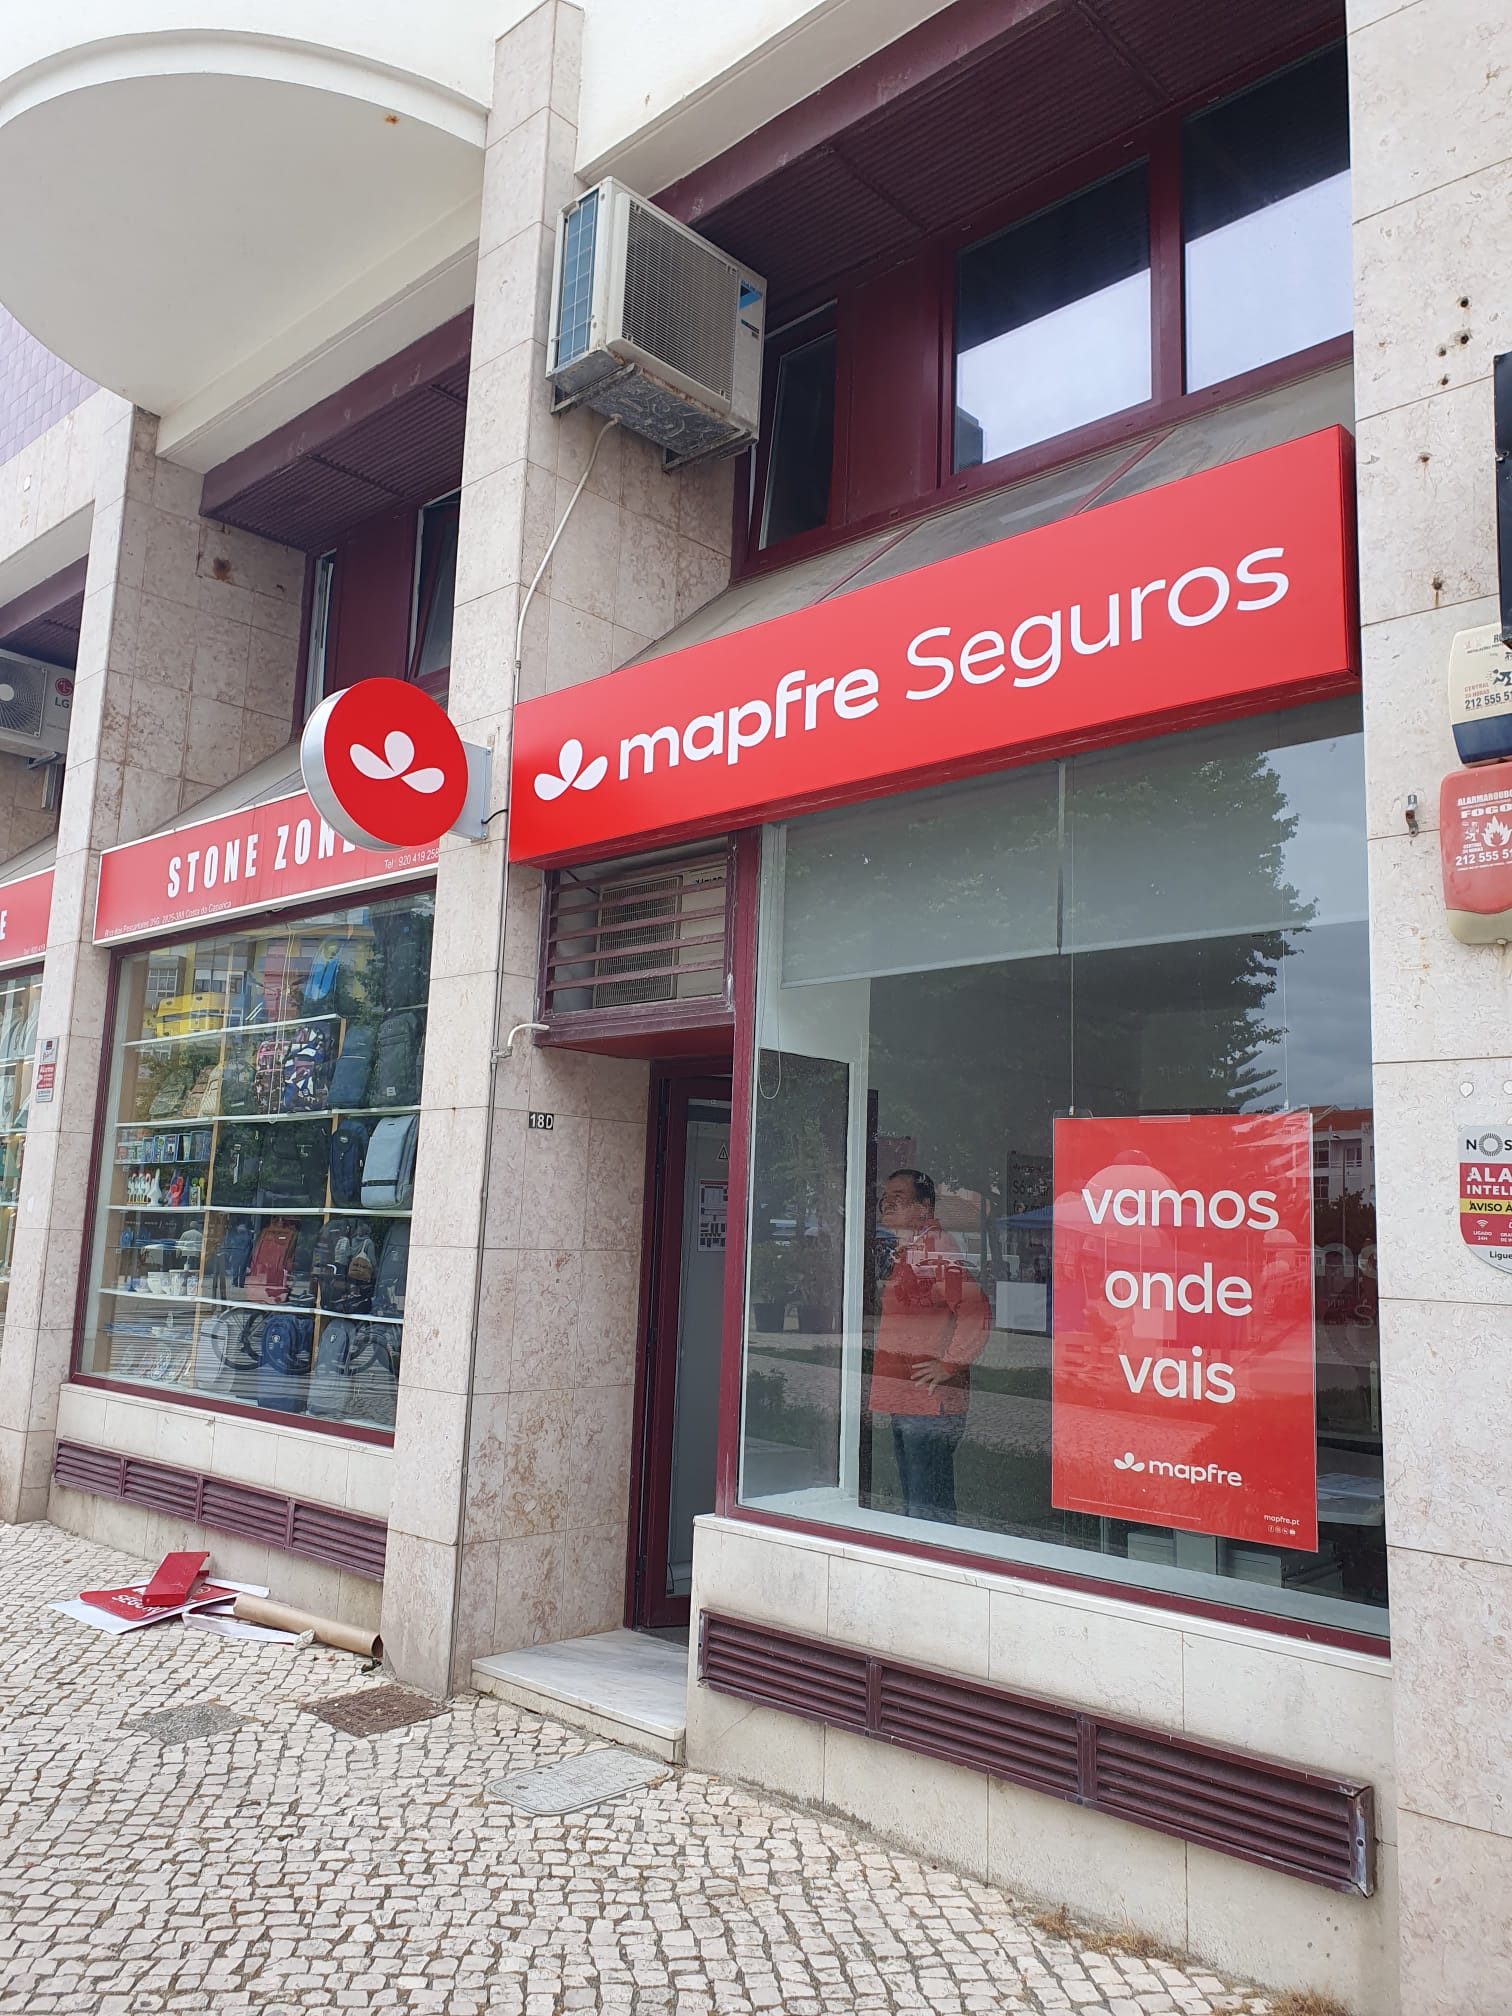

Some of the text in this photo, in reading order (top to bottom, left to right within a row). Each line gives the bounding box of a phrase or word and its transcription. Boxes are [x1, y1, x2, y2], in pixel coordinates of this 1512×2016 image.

[619, 547, 1290, 781] mapfre Seguros
[55, 696, 70, 709] LG
[1465, 697, 1482, 710] 212
[1484, 693, 1502, 706] 555
[1461, 803, 1512, 819] FOGO
[167, 832, 260, 899] STONE
[399, 854, 411, 866] 920
[412, 850, 426, 864] 419
[1456, 853, 1476, 866] 212
[1479, 850, 1499, 863] 555
[530, 1113, 553, 1129] 18D
[1466, 1132, 1512, 1157] NOS
[1081, 1187, 1280, 1231] vamos
[1469, 1202, 1503, 1213] AVISO
[1489, 1250, 1512, 1261] Ligue
[1104, 1262, 1254, 1317] onde
[1118, 1345, 1237, 1404] vais
[1149, 1459, 1244, 1487] mapfre
[1263, 1514, 1300, 1526] mapfre.pt
